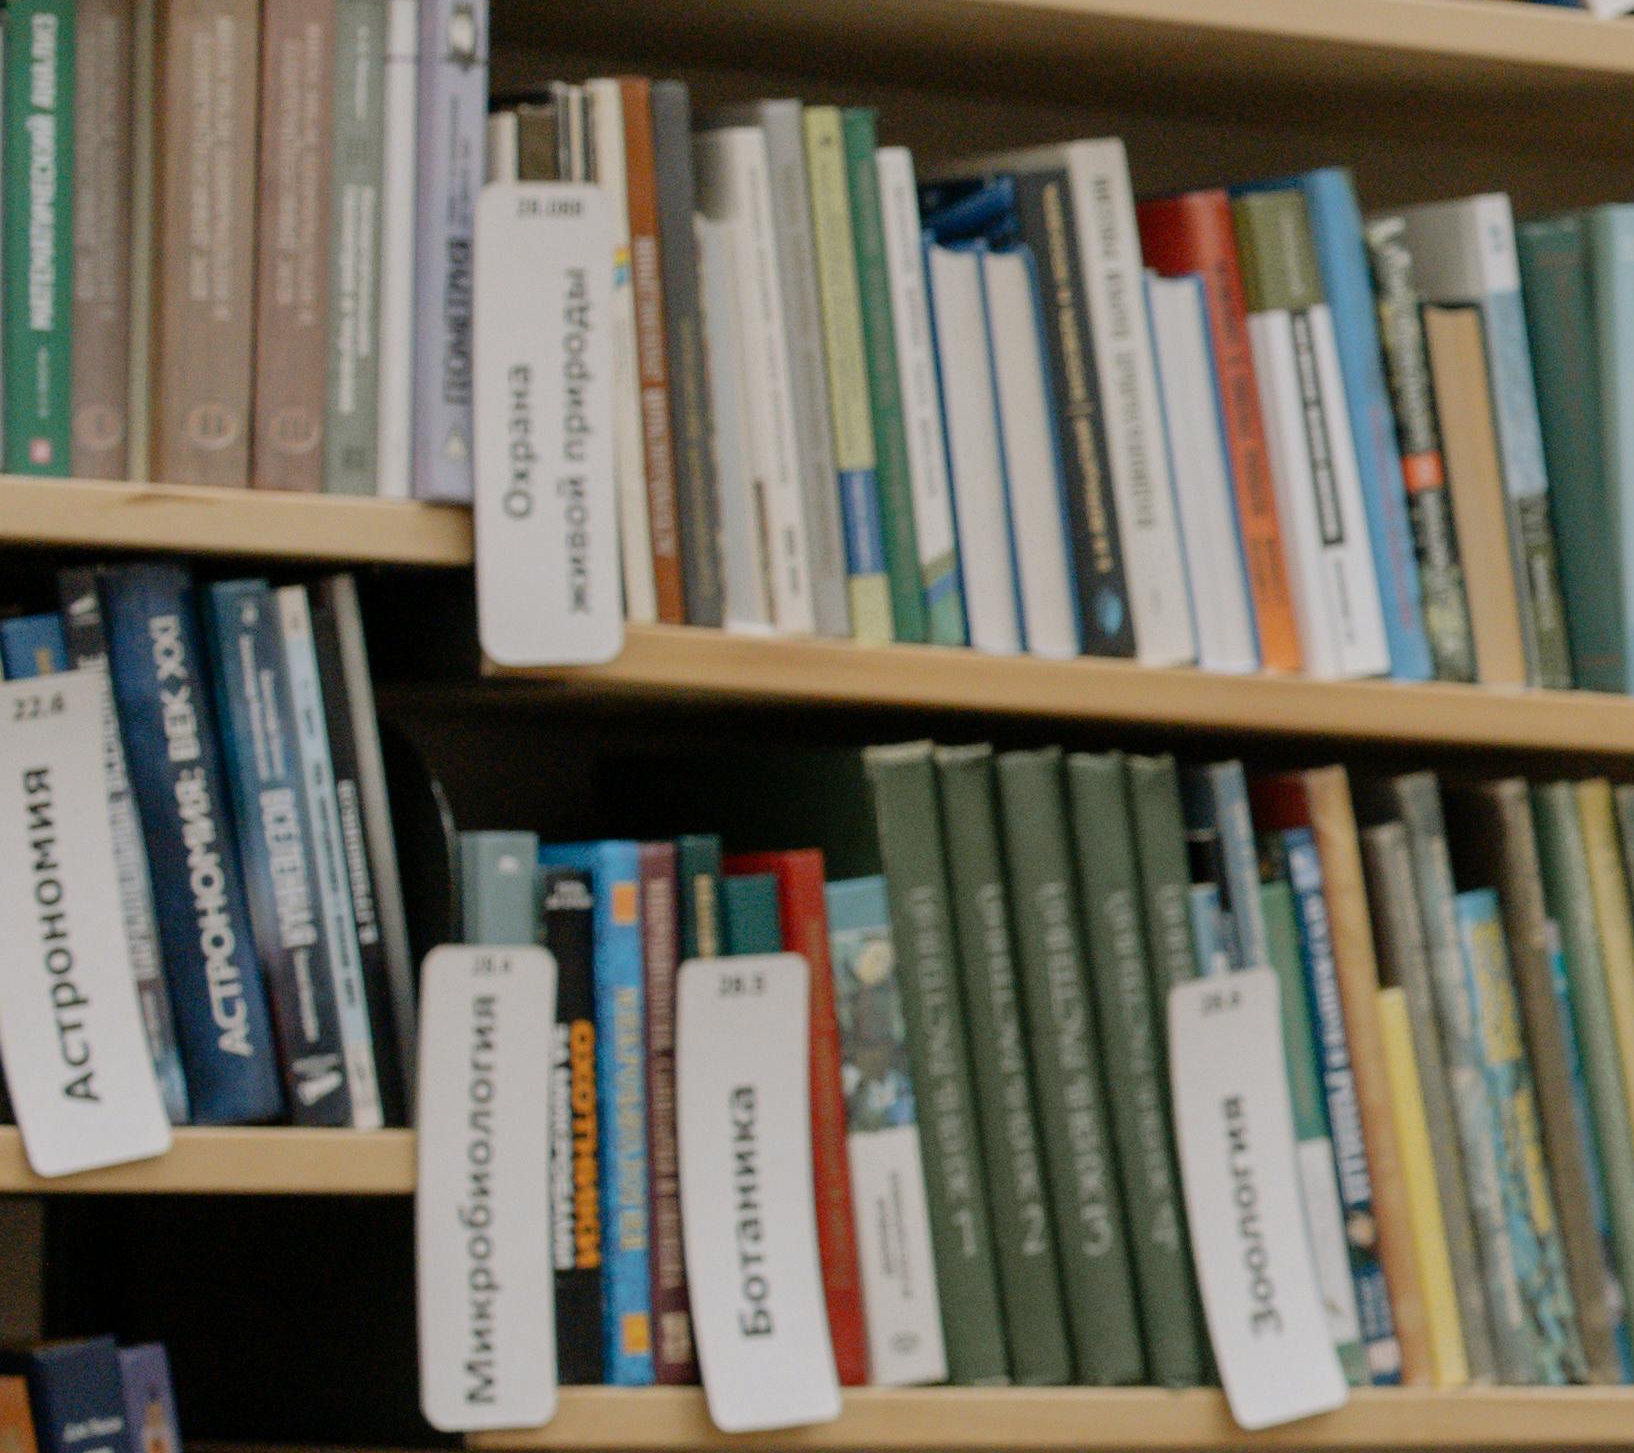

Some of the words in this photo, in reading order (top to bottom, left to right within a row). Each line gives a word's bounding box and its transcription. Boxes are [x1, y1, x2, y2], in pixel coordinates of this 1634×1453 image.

[28, 12, 58, 110] АНАЛИЗ
[26, 113, 57, 331] МАТЕМАТИЧЕСКИЙ
[503, 362, 538, 520] Охрана
[556, 267, 591, 462] природы
[148, 614, 188, 680] XXI
[555, 477, 591, 615] живой
[160, 684, 197, 760] ВЕК
[21, 766, 99, 1104] Астрономия
[174, 768, 253, 1057] АСТРОНОМИЯ:
[458, 994, 501, 1407] Микробиология
[727, 1082, 776, 1339] Ботаника
[1219, 1094, 1285, 1339] Зоология
